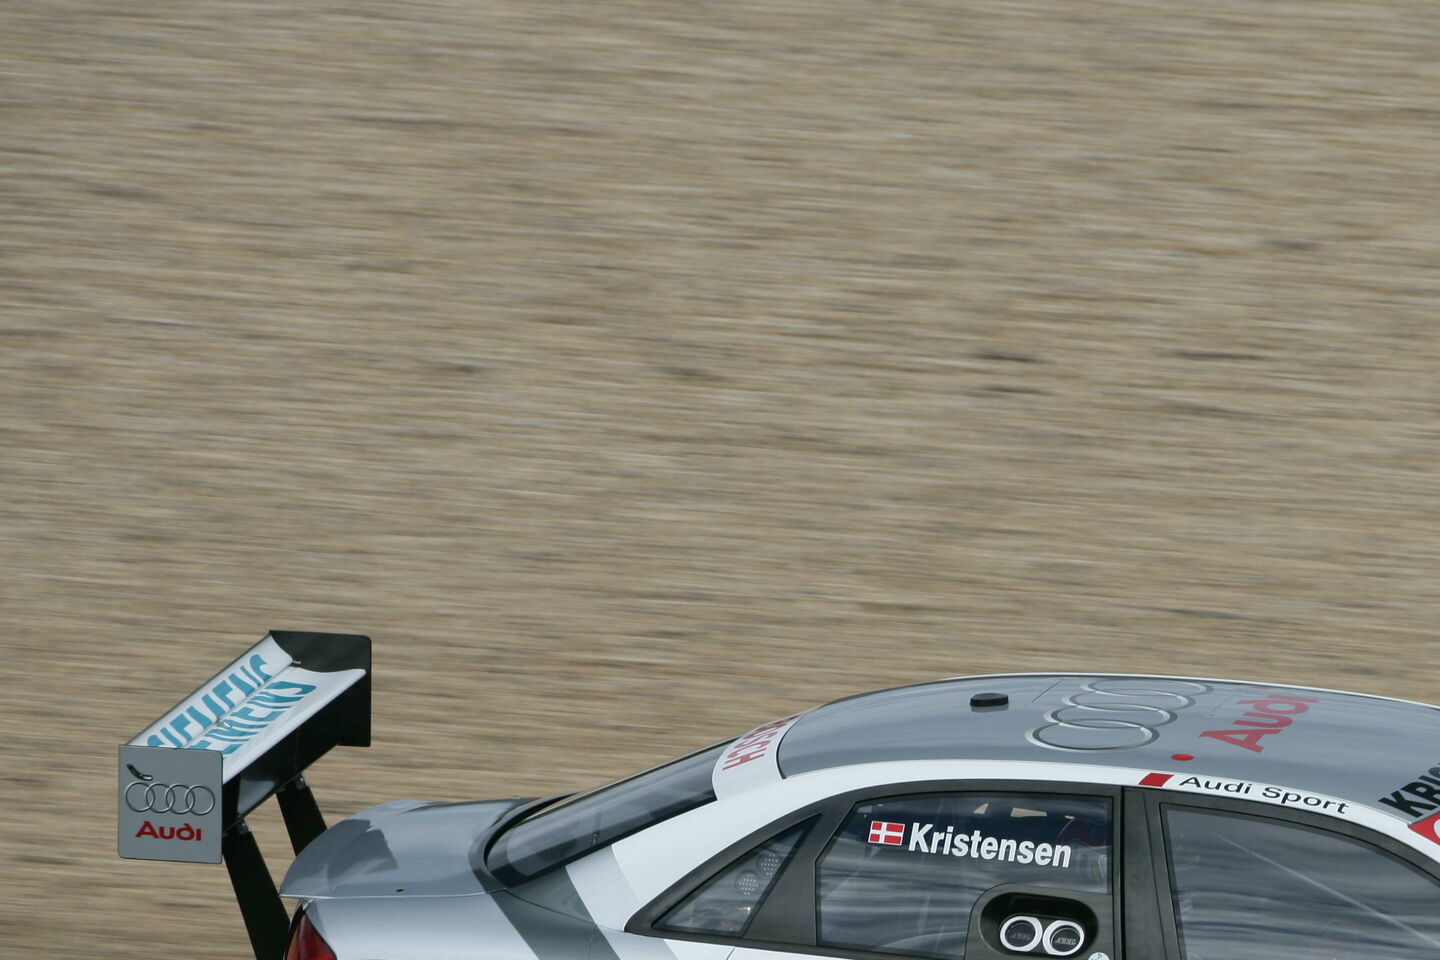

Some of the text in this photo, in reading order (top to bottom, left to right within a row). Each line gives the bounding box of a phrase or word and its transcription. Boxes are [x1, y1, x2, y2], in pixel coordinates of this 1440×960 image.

[1199, 695, 1318, 753] Audi
[1179, 777, 1349, 814] Audi Sport
[135, 821, 202, 841] Audi
[908, 822, 1072, 868] Kristensen
